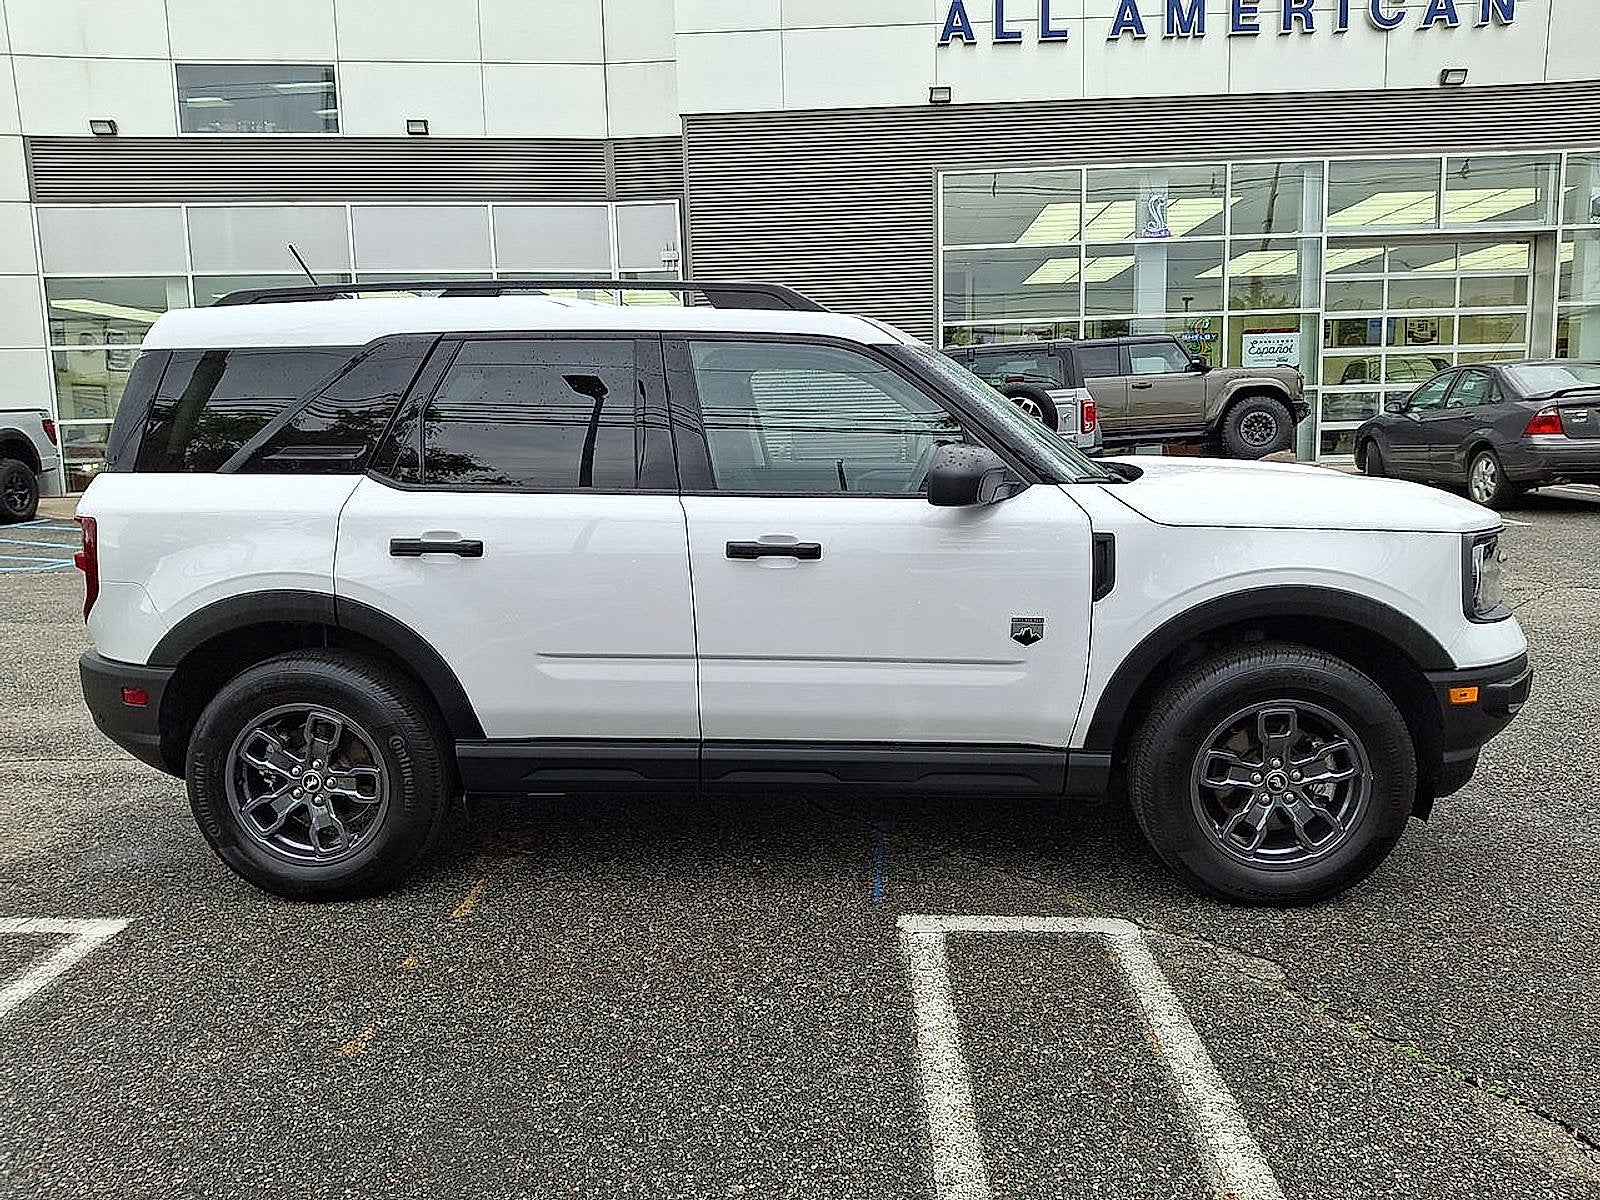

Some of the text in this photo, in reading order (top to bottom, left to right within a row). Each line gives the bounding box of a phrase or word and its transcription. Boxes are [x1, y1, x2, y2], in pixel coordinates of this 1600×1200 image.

[938, 0, 1516, 43] ALL AMERICAN
[1248, 340, 1294, 356] Español
